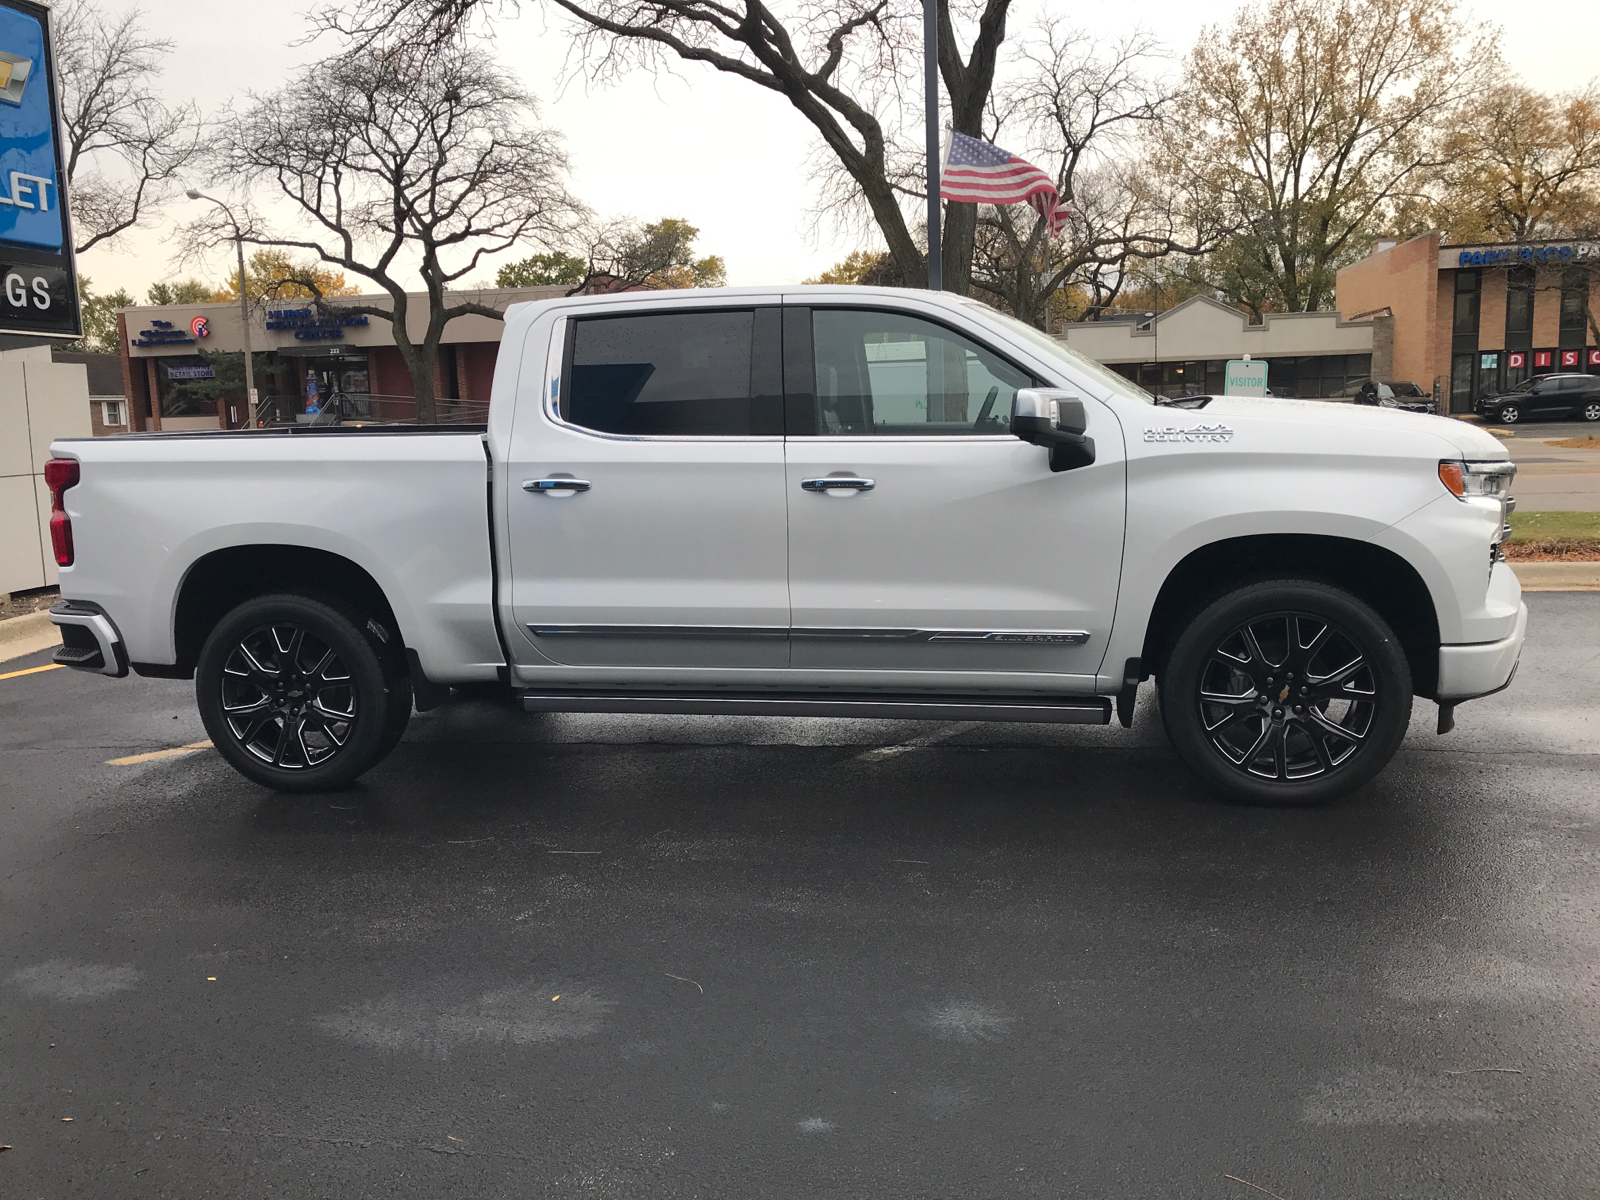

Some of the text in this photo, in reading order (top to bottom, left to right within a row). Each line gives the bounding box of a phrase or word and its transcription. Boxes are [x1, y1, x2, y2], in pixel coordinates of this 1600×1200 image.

[1229, 377, 1264, 388] VISITOR
[1143, 426, 1188, 435] HIGH
[1143, 434, 1233, 443] COUNTRY
